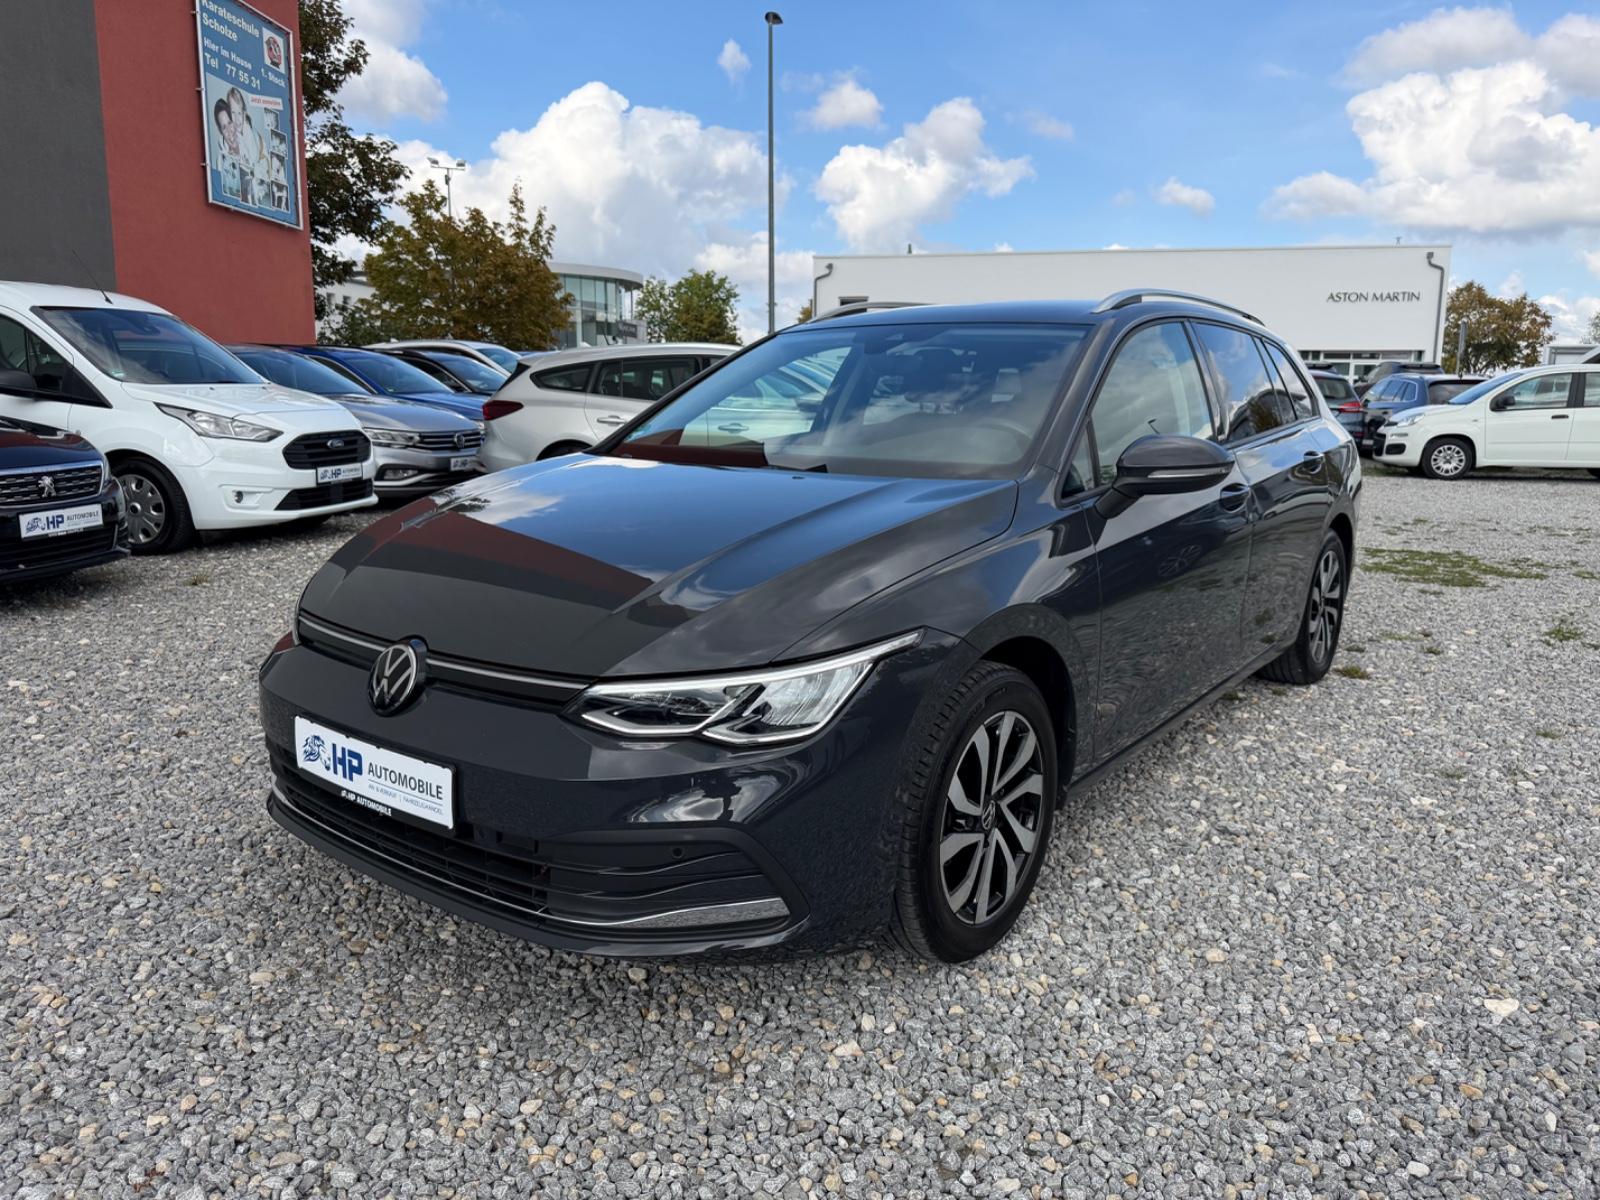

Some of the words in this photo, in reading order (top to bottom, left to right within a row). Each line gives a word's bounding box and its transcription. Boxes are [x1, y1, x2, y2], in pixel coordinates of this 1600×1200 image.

[202, 12, 239, 42] Scholze
[204, 37, 219, 53] Hier
[220, 45, 230, 59] im
[204, 52, 219, 70] Tel
[225, 63, 236, 78] 77
[239, 70, 249, 84] 55
[251, 76, 261, 91] 31
[1326, 291, 1369, 303] ASTON
[1371, 291, 1421, 303] MARTIN
[46, 514, 64, 530] HP
[66, 510, 99, 521] AUTOMOBILE
[332, 742, 363, 782] HP
[367, 762, 444, 801] AUTOMOBILE
